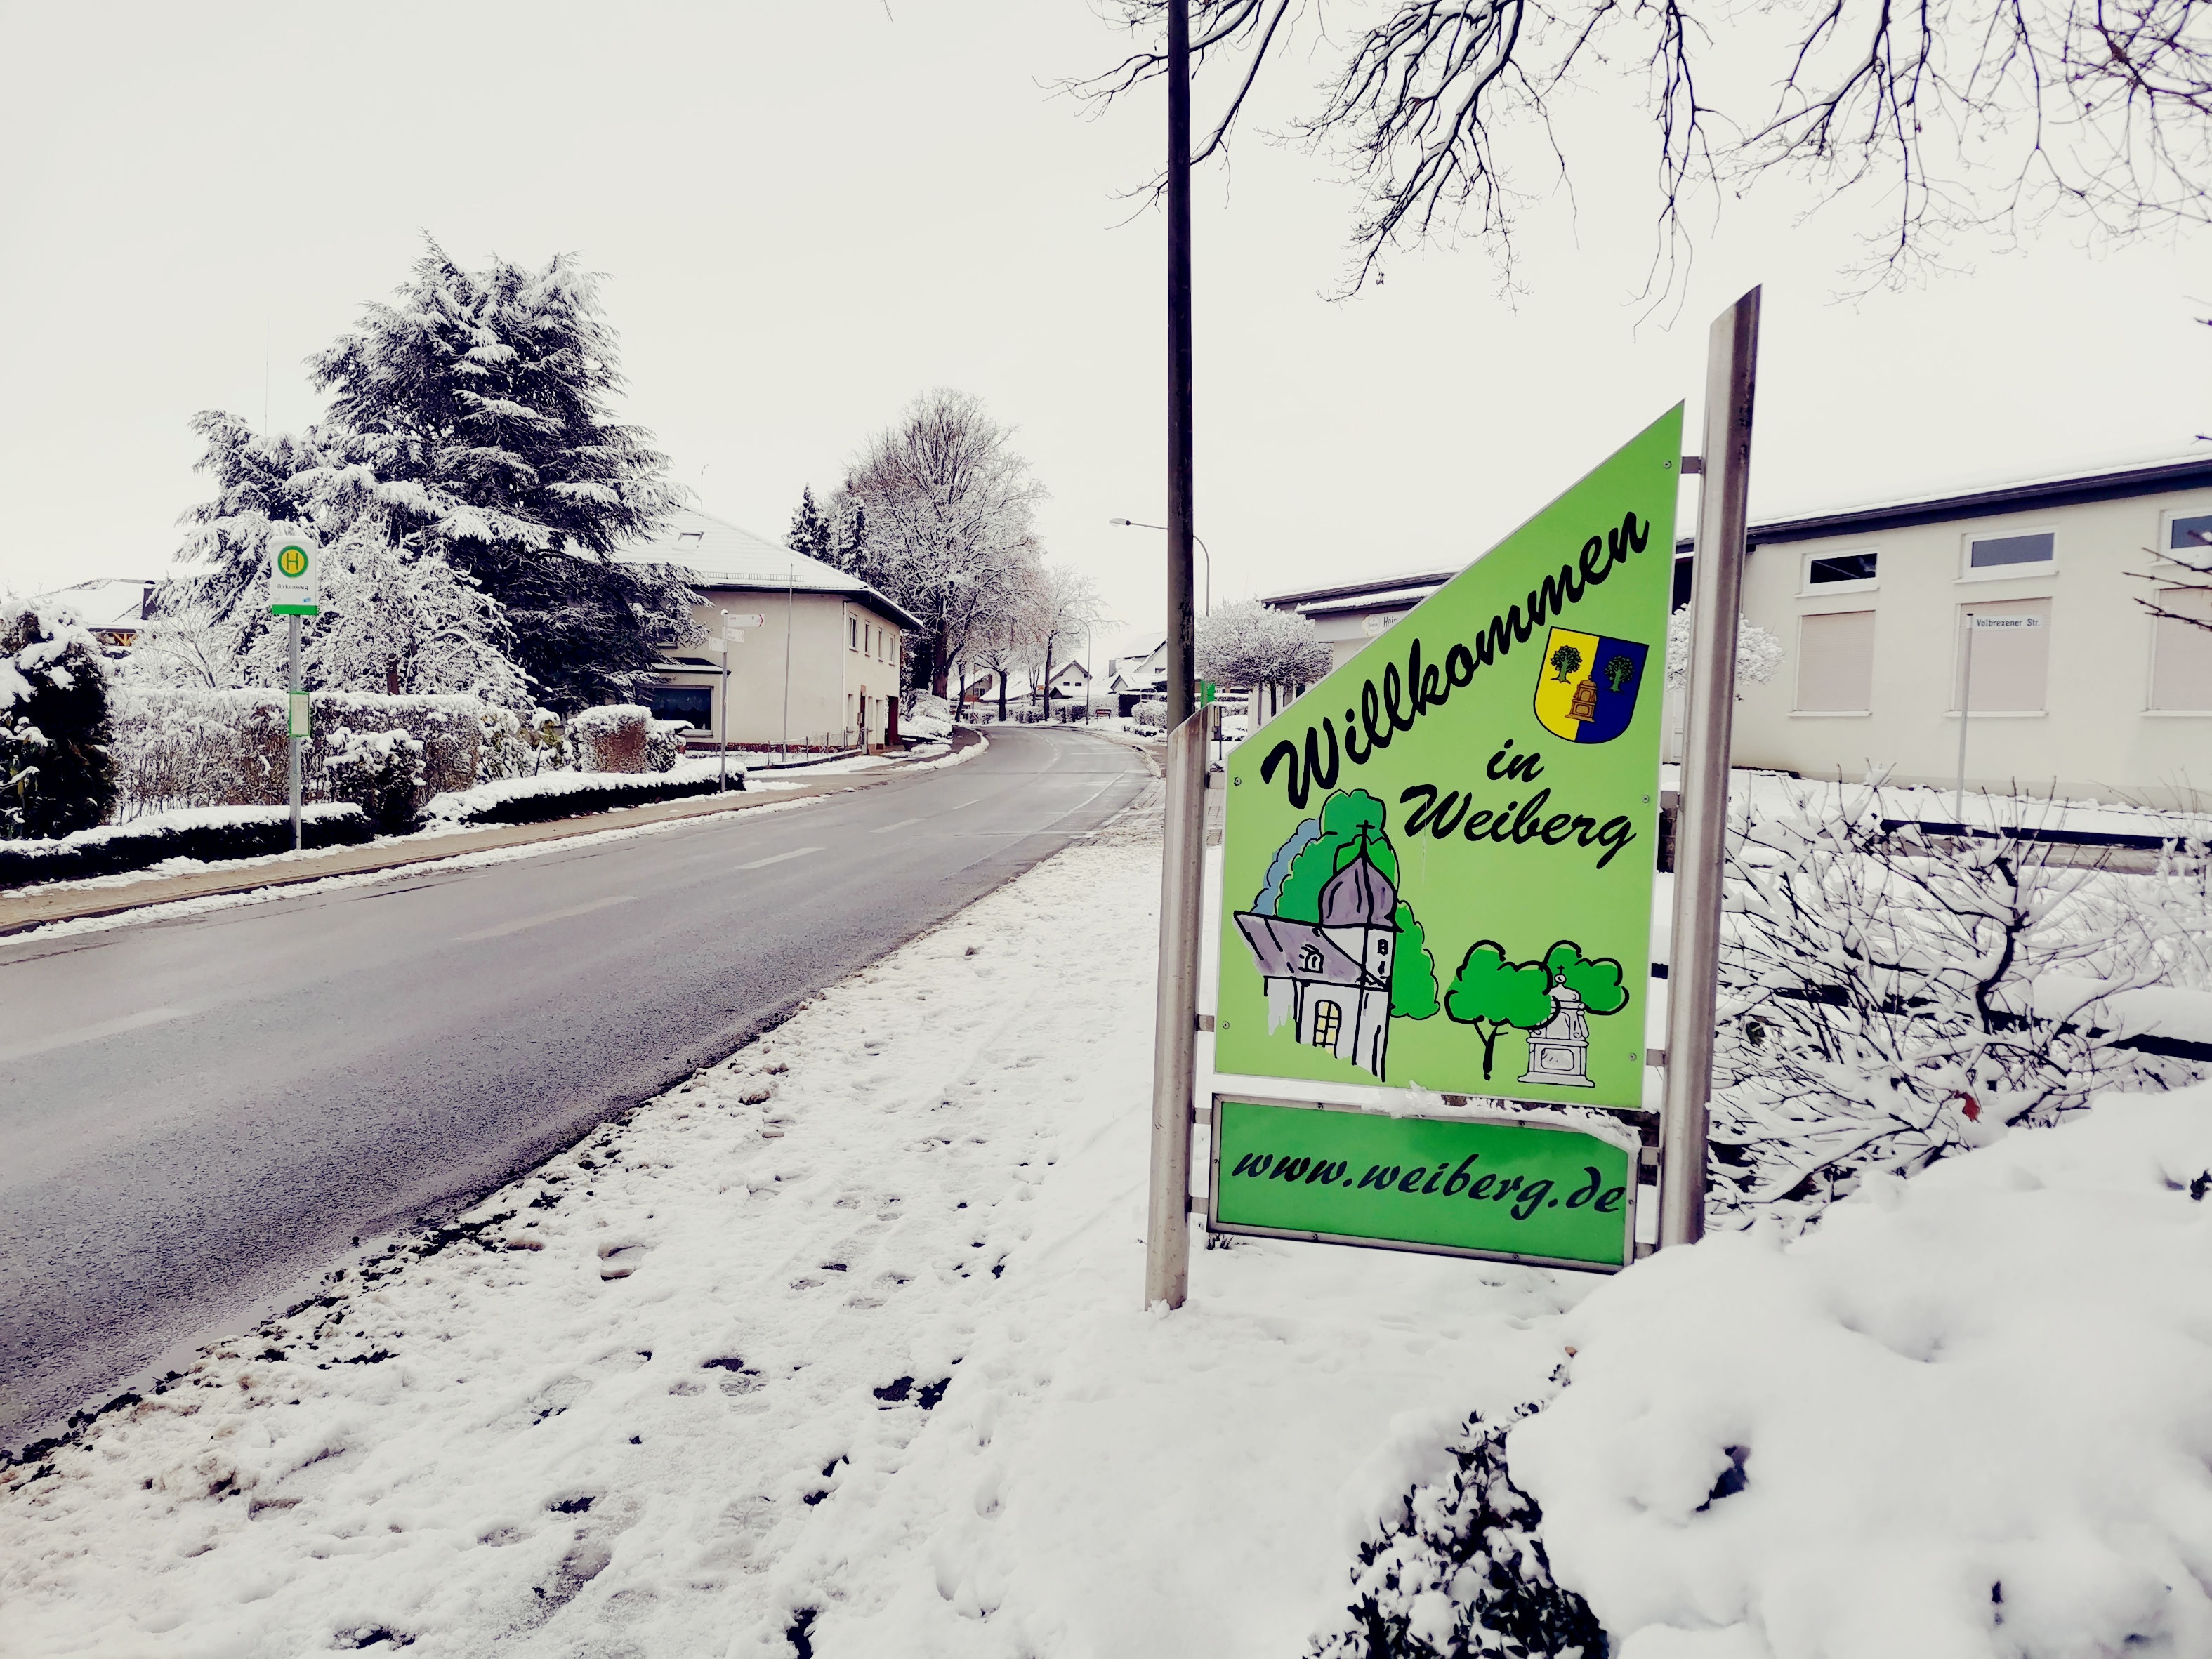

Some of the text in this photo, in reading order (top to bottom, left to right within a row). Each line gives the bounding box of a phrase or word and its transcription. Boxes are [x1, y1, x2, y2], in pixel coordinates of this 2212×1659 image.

[286, 553, 299, 570] H
[1977, 618, 2040, 627] Volbrexener Str.
[1260, 512, 1650, 809] Willkommen
[1487, 739, 1545, 783] in
[1399, 784, 1637, 869] Weiberg
[1231, 1152, 1626, 1221] www.weiberg.de
